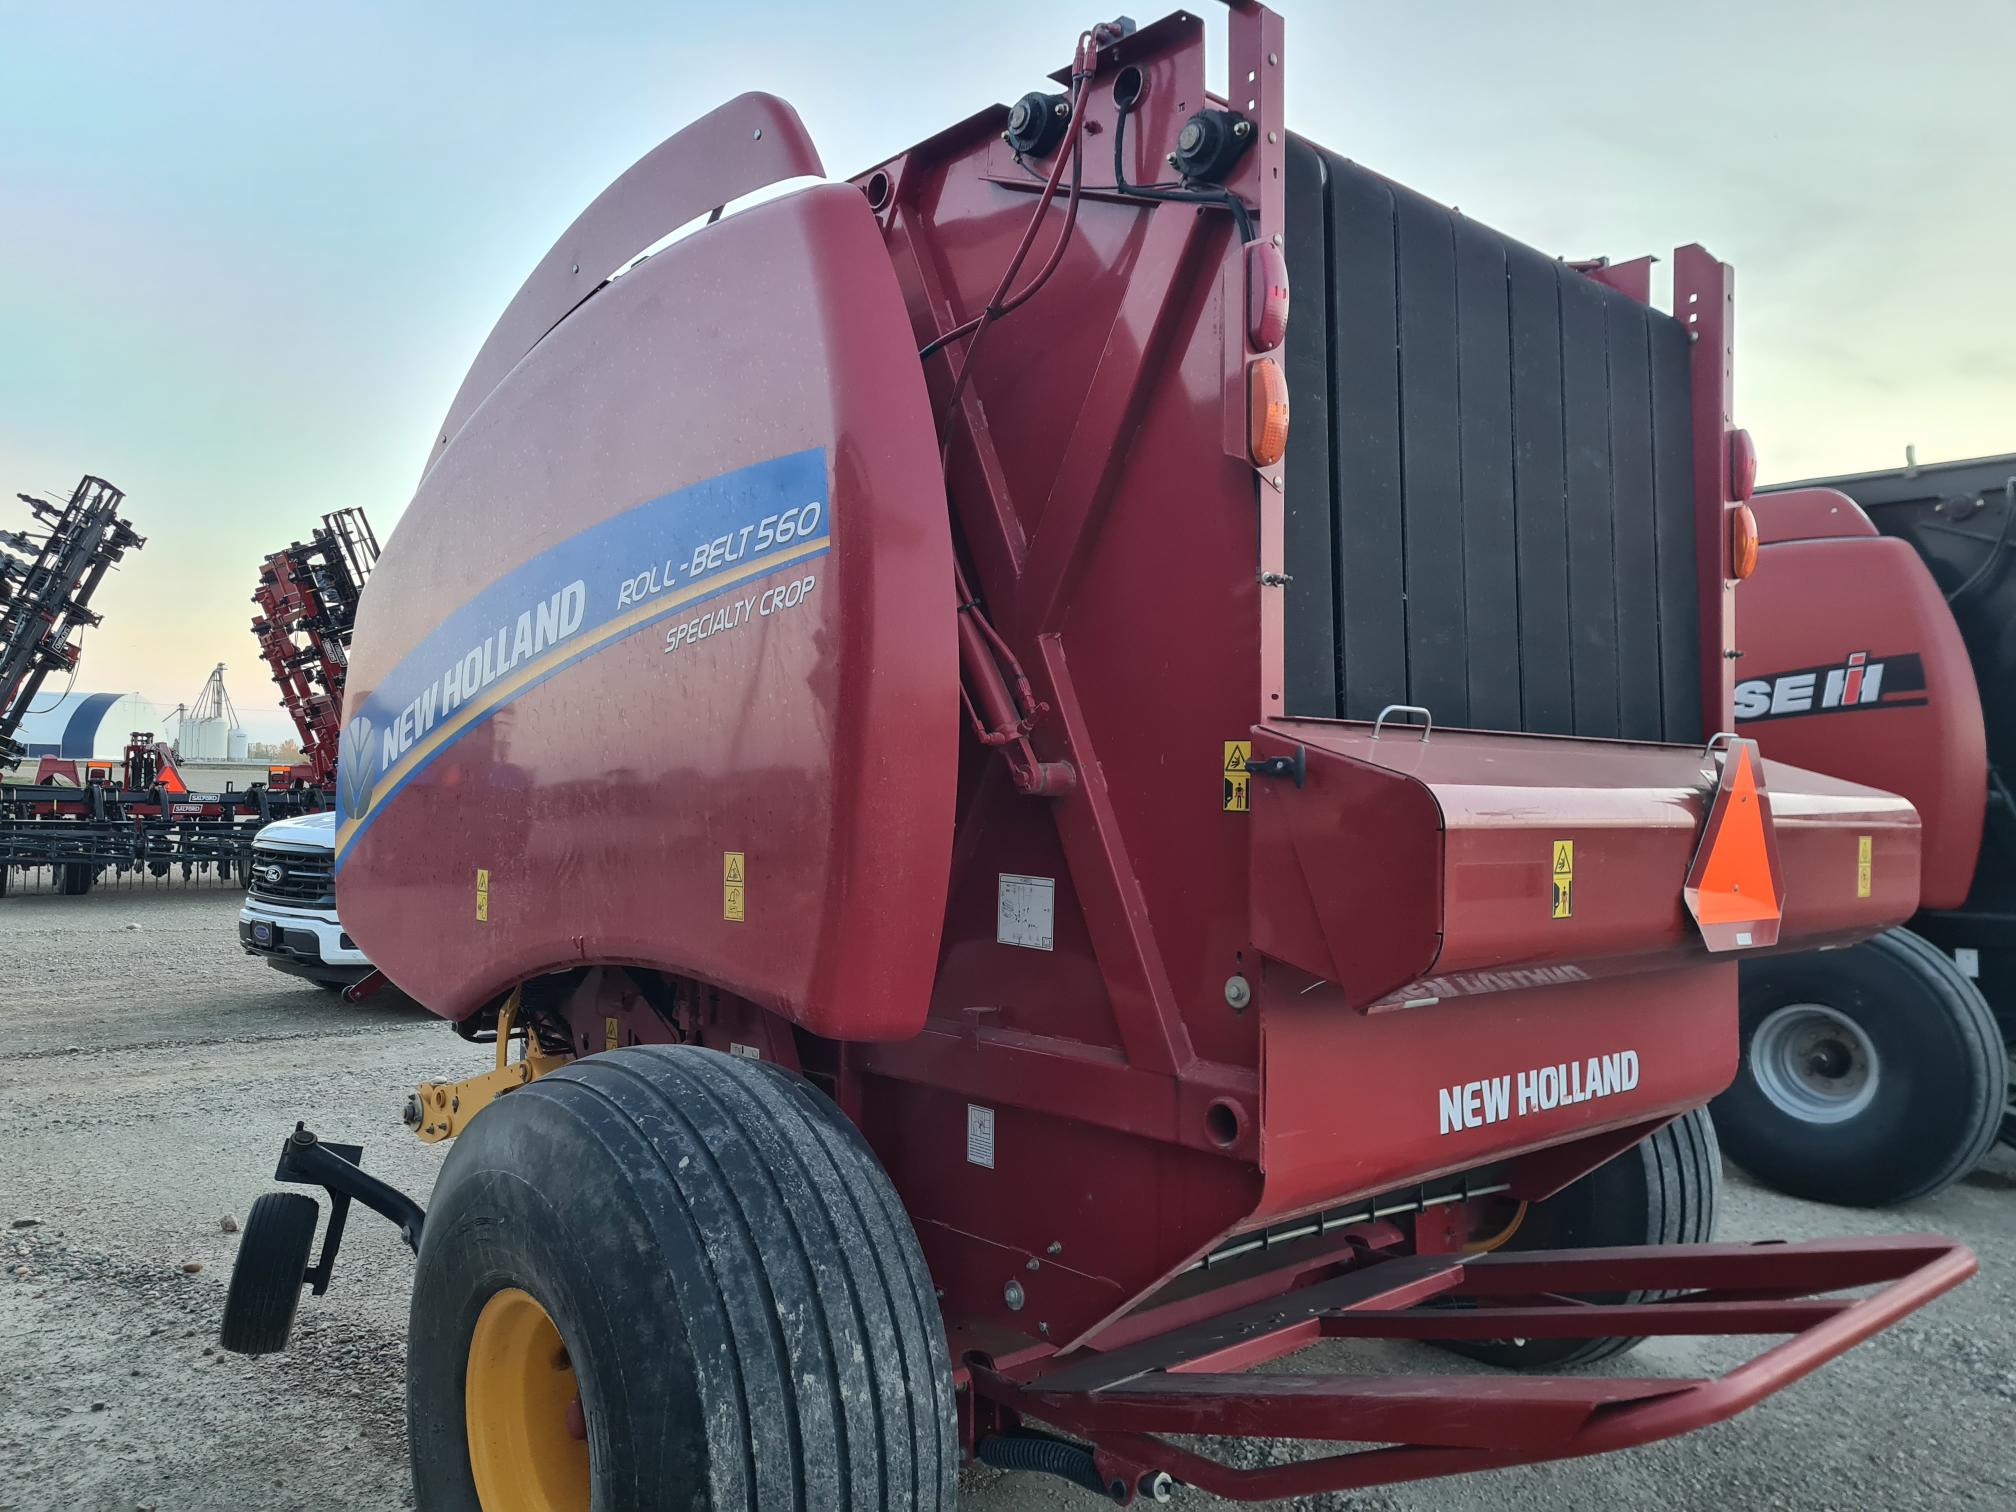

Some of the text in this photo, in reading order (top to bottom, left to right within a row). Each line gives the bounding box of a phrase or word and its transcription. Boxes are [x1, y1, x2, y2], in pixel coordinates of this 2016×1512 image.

[754, 501, 822, 552] 560
[664, 575, 816, 654] SPECIALTY CROP
[382, 579, 586, 772] NEW HOLLAND
[1734, 673, 1817, 719] SE
[1439, 1049, 1640, 1135] NEW HOLLAND
